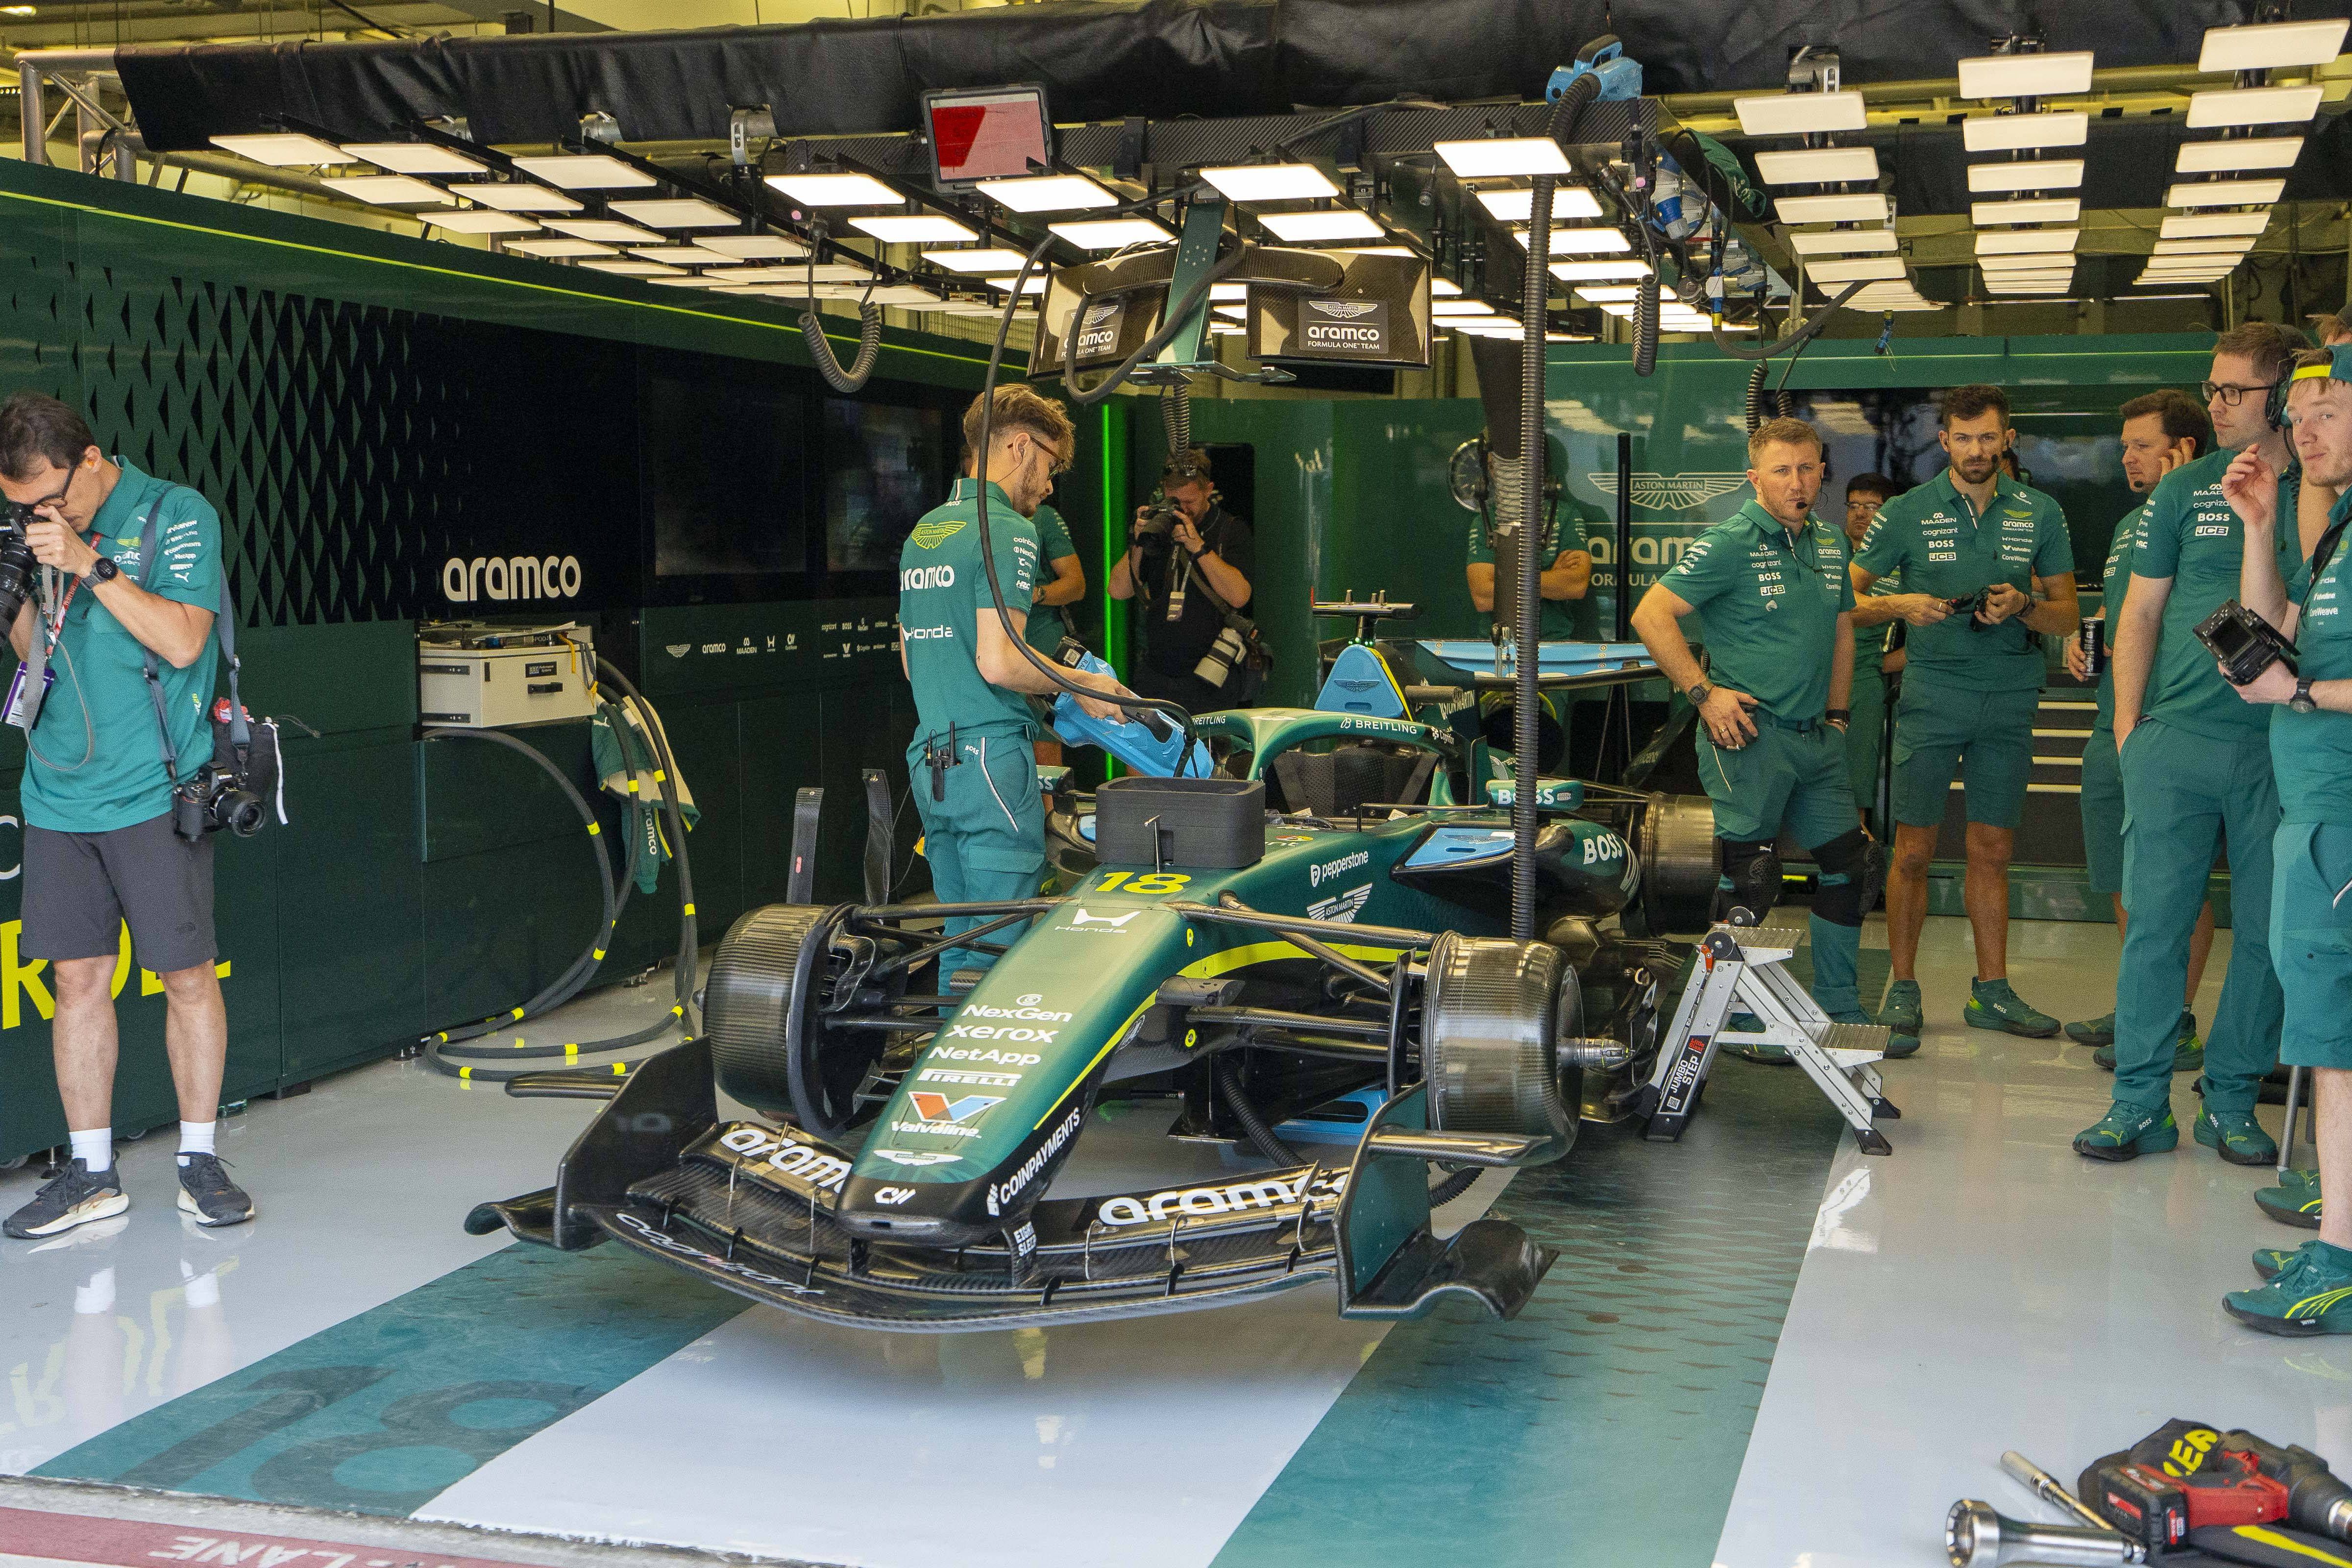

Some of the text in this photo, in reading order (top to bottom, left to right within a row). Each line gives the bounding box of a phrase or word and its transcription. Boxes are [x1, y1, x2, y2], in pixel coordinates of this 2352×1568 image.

[1308, 326, 1379, 341] aramco
[2198, 513, 2230, 522] BOSS
[1922, 527, 1959, 537] cognizant
[1929, 540, 1955, 548] BOSS
[2002, 554, 2030, 563] CoreWeave
[443, 556, 581, 601] aramco
[1758, 572, 1781, 582] BOSS
[1762, 586, 1785, 595] JCB
[2309, 607, 2338, 617] CoreWeave
[842, 622, 852, 631] BOSS
[702, 643, 726, 654] aramco
[1355, 719, 1417, 735] BREITLING
[965, 744, 980, 755] BOSS
[645, 807, 658, 856] aramco
[1583, 834, 1623, 865] BOSS
[1322, 851, 1369, 882] pepperstone
[1095, 872, 1191, 894] 18
[1325, 899, 1354, 917] ASTON MARTIN
[961, 1004, 1073, 1022] NexGen
[1993, 1003, 2007, 1014] BOSS
[945, 1025, 1059, 1044] xerox
[928, 1046, 1041, 1066] NetApp
[916, 1068, 1022, 1087] PIRELLI
[1670, 1059, 1689, 1094] JUMBO
[1682, 1055, 1699, 1085] STEP
[2138, 1117, 2153, 1130] BOSS
[1000, 1107, 1080, 1205] COINPAYMENTS
[616, 1213, 826, 1295] cognizant
